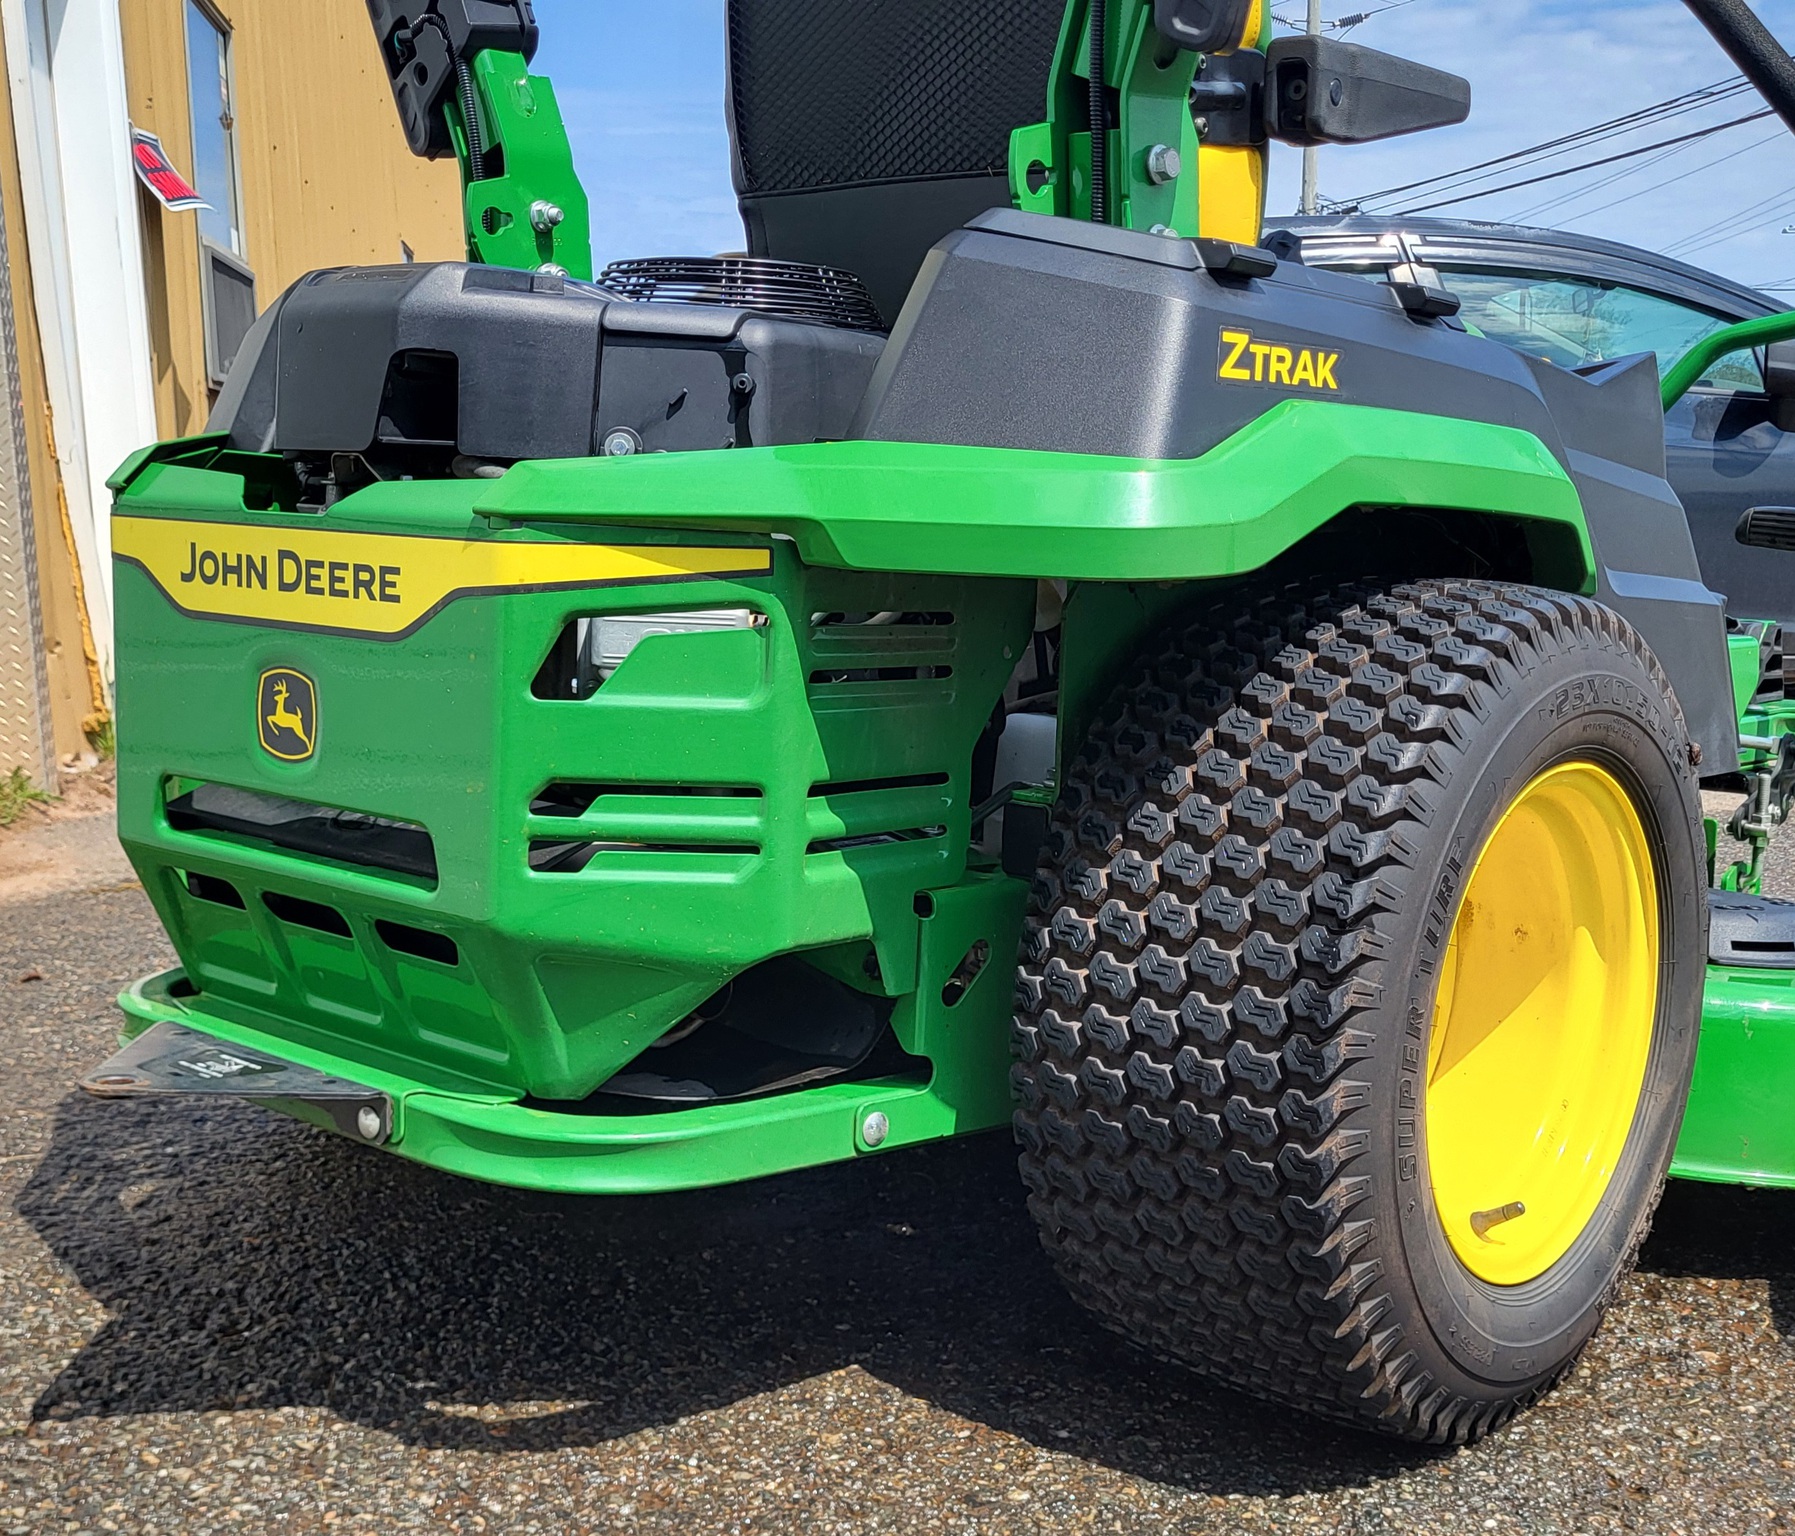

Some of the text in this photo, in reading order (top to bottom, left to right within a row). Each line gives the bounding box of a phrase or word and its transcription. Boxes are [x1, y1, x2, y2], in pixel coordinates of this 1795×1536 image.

[1219, 331, 1338, 389] ZTRAK
[180, 542, 401, 603] JOHN DEERE
[1398, 1003, 1426, 1182] SUPER
